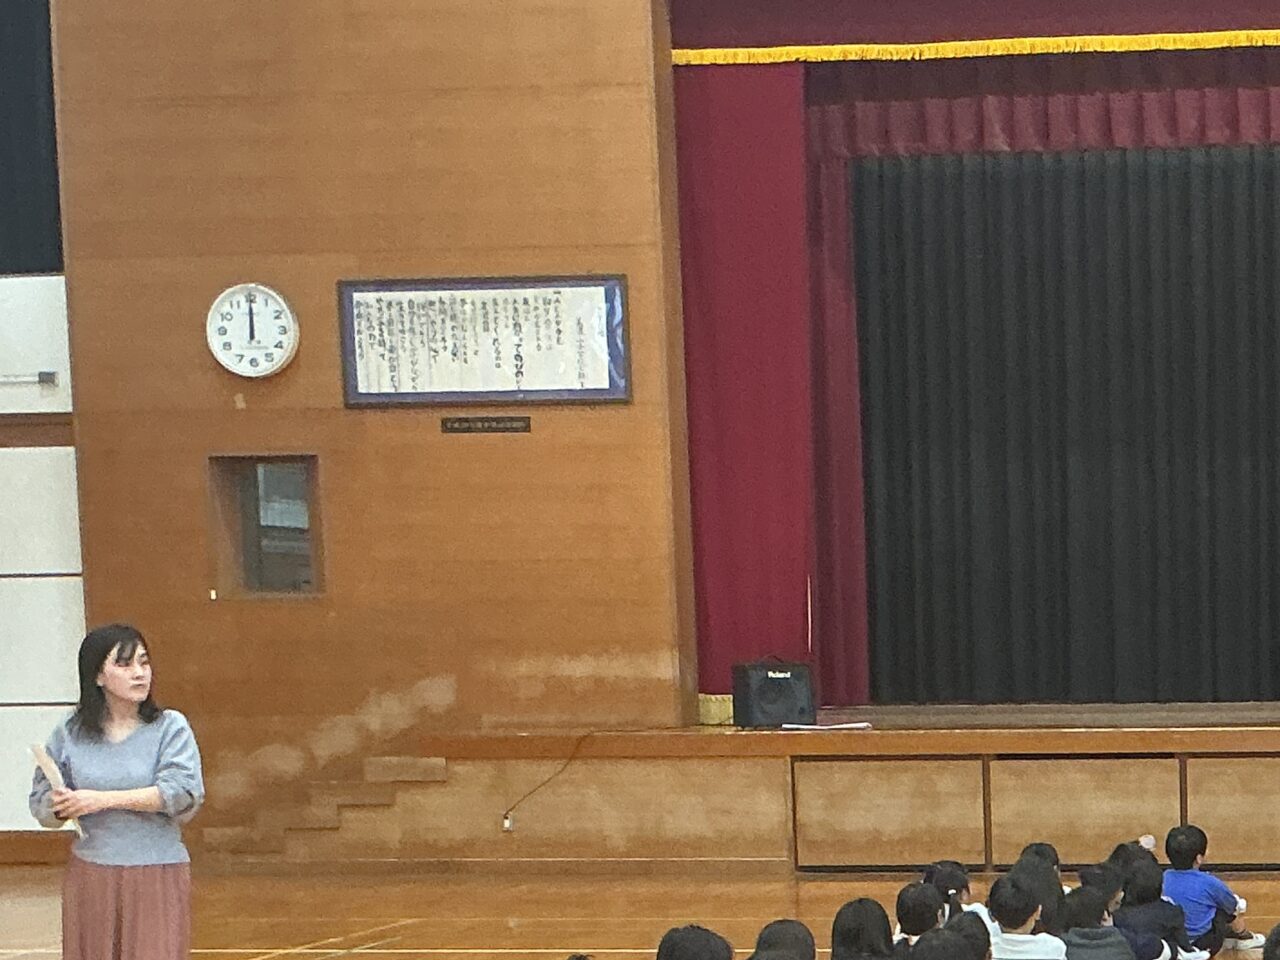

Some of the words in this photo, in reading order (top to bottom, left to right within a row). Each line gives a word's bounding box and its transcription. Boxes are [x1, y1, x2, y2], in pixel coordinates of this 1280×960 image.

[245, 293, 256, 303] 12
[230, 301, 240, 309] 11
[221, 312, 233, 321] 10
[274, 310, 283, 319] 2
[218, 326, 227, 335] 9
[279, 326, 287, 335] 3
[223, 342, 232, 351] 8
[274, 341, 283, 349] 4
[235, 355, 244, 363] 7
[265, 353, 274, 362] 5
[250, 358, 258, 367] 6
